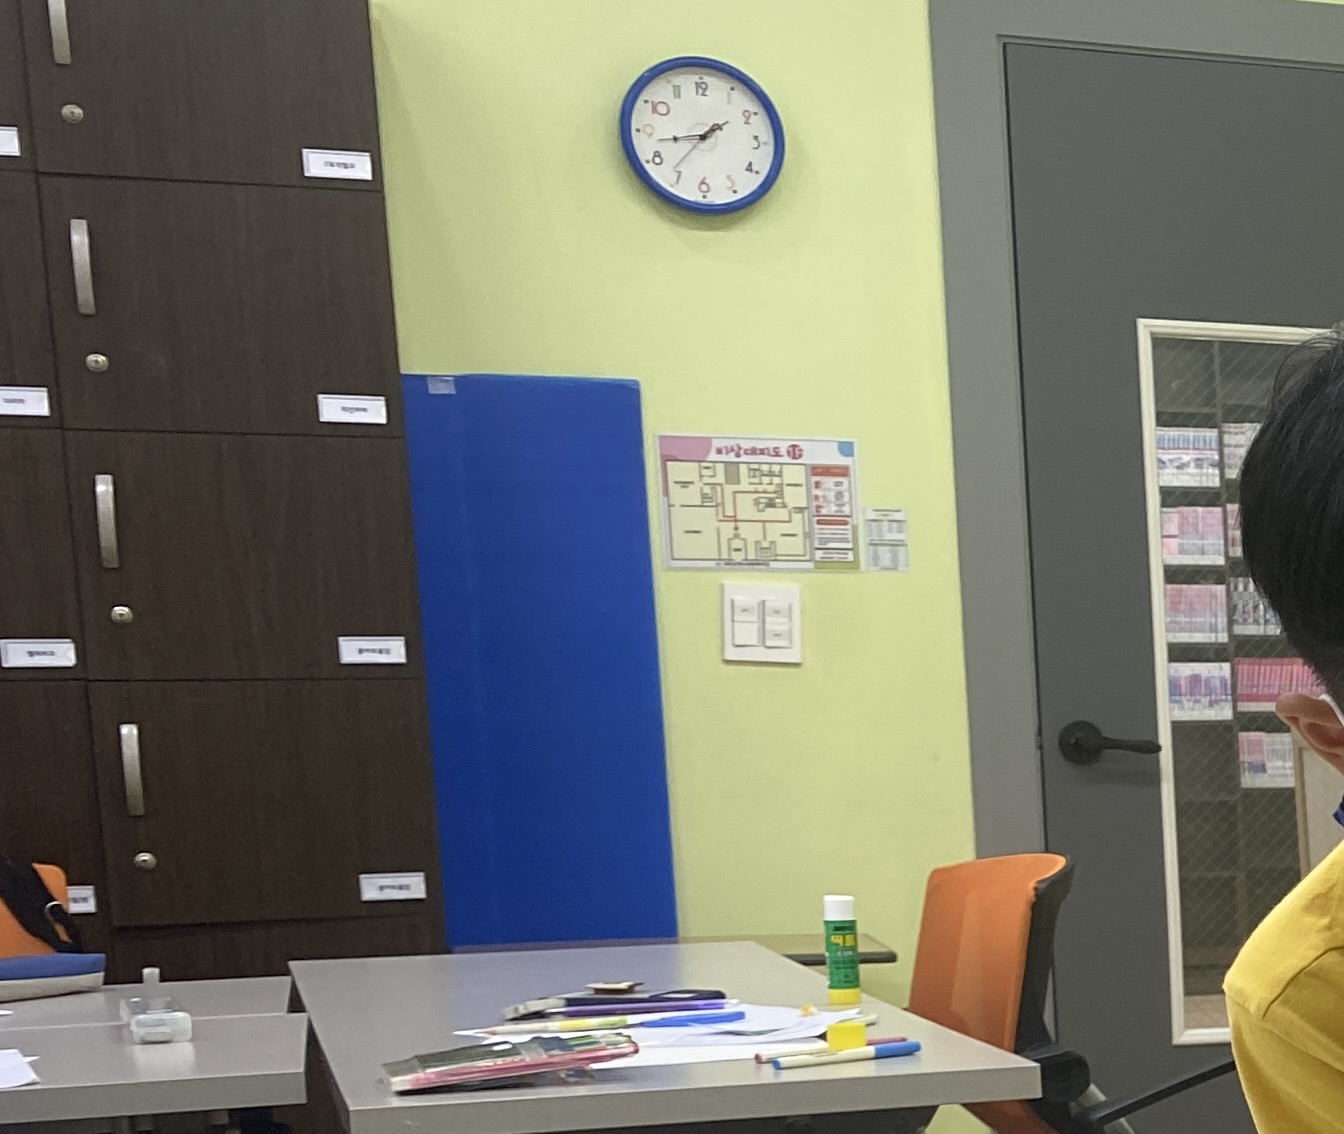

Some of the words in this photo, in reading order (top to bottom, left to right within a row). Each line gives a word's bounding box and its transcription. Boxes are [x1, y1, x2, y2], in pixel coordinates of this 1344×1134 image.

[694, 81, 709, 97] 12
[650, 100, 671, 117] 10
[741, 109, 753, 126] 2
[651, 150, 664, 166] 8
[674, 170, 683, 185] 7
[697, 175, 711, 194] 6
